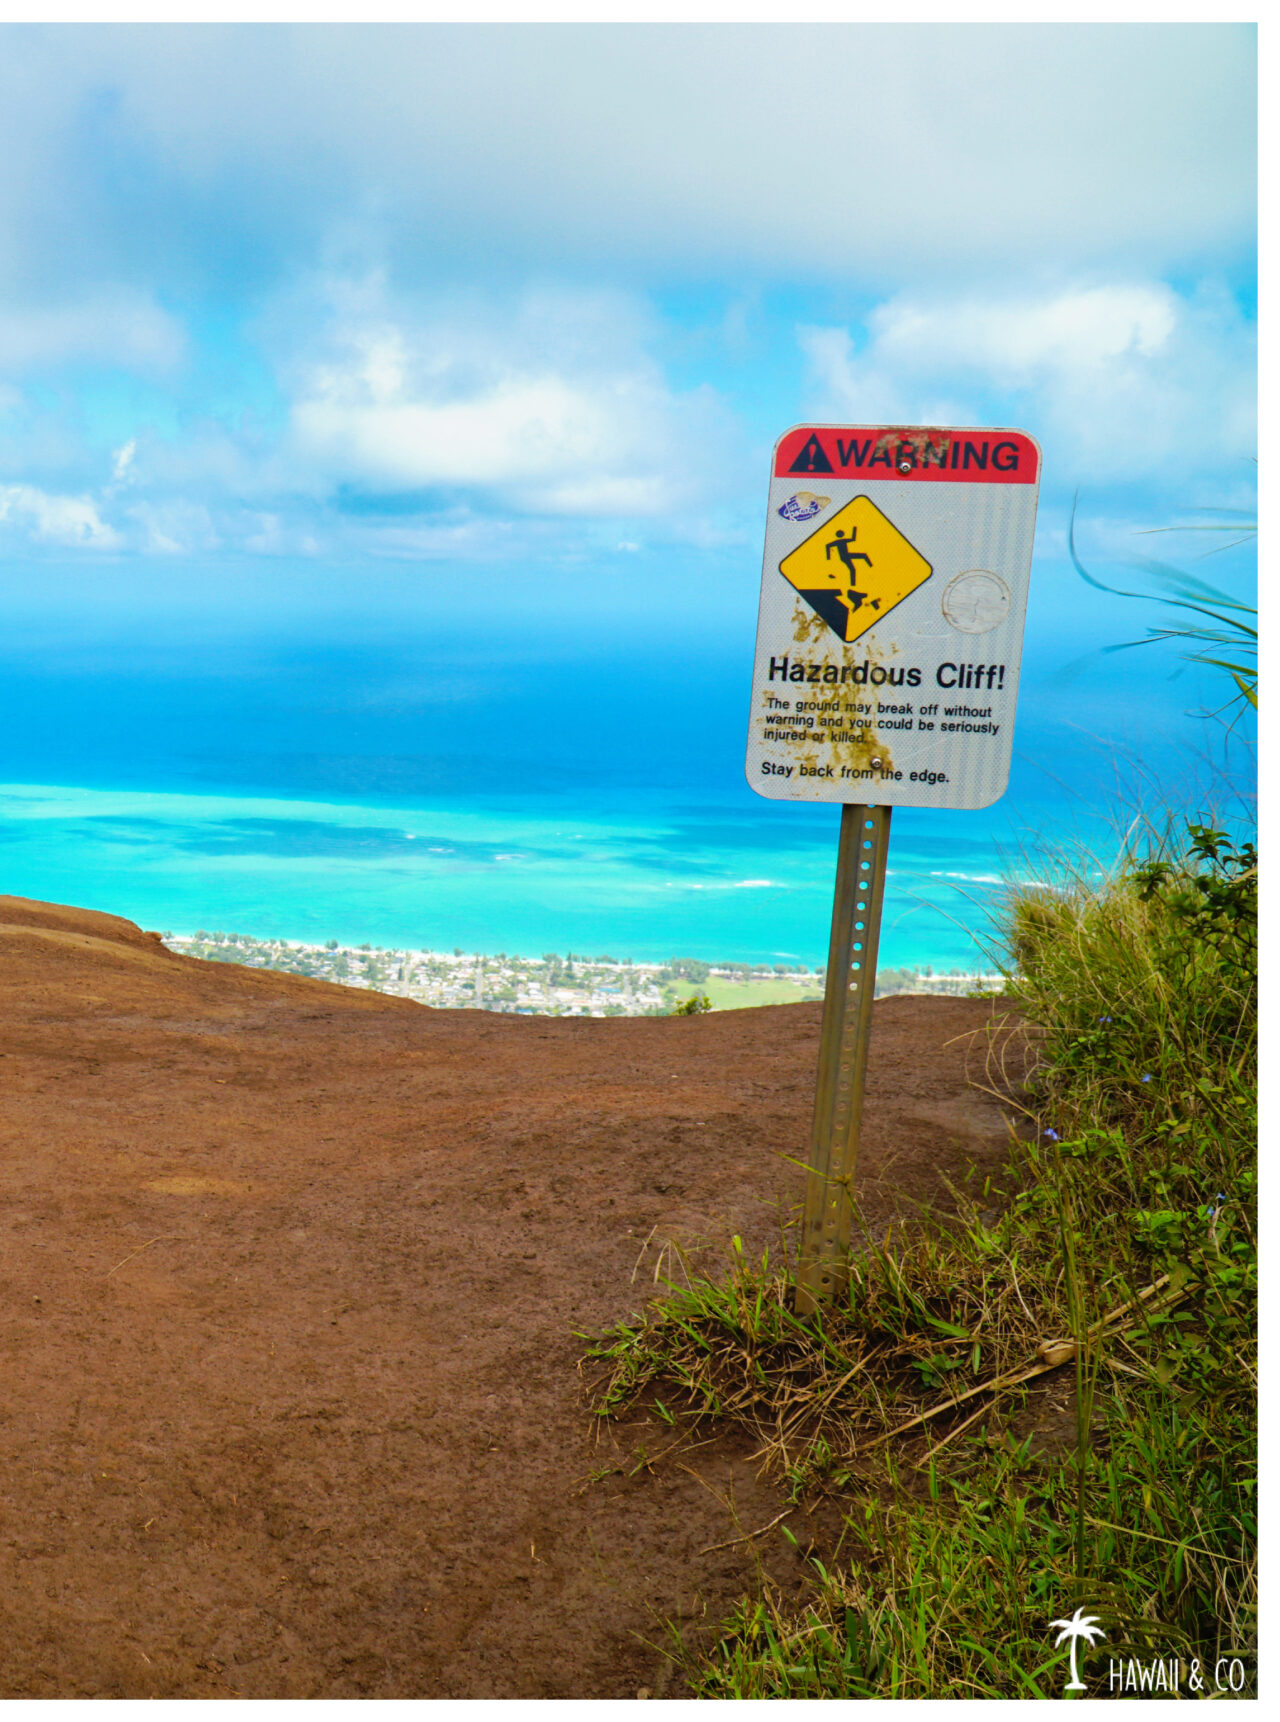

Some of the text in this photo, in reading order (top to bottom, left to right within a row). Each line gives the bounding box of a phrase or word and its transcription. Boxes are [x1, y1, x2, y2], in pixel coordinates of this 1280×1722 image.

[836, 439, 1019, 472] WARNING
[768, 656, 1005, 690] Hazardous Cliff!
[767, 698, 992, 718] The ground may break off without
[763, 728, 867, 744] injured or killed.
[765, 714, 1000, 736] warning and you could be seriously
[761, 761, 949, 785] Stay back from the edge.
